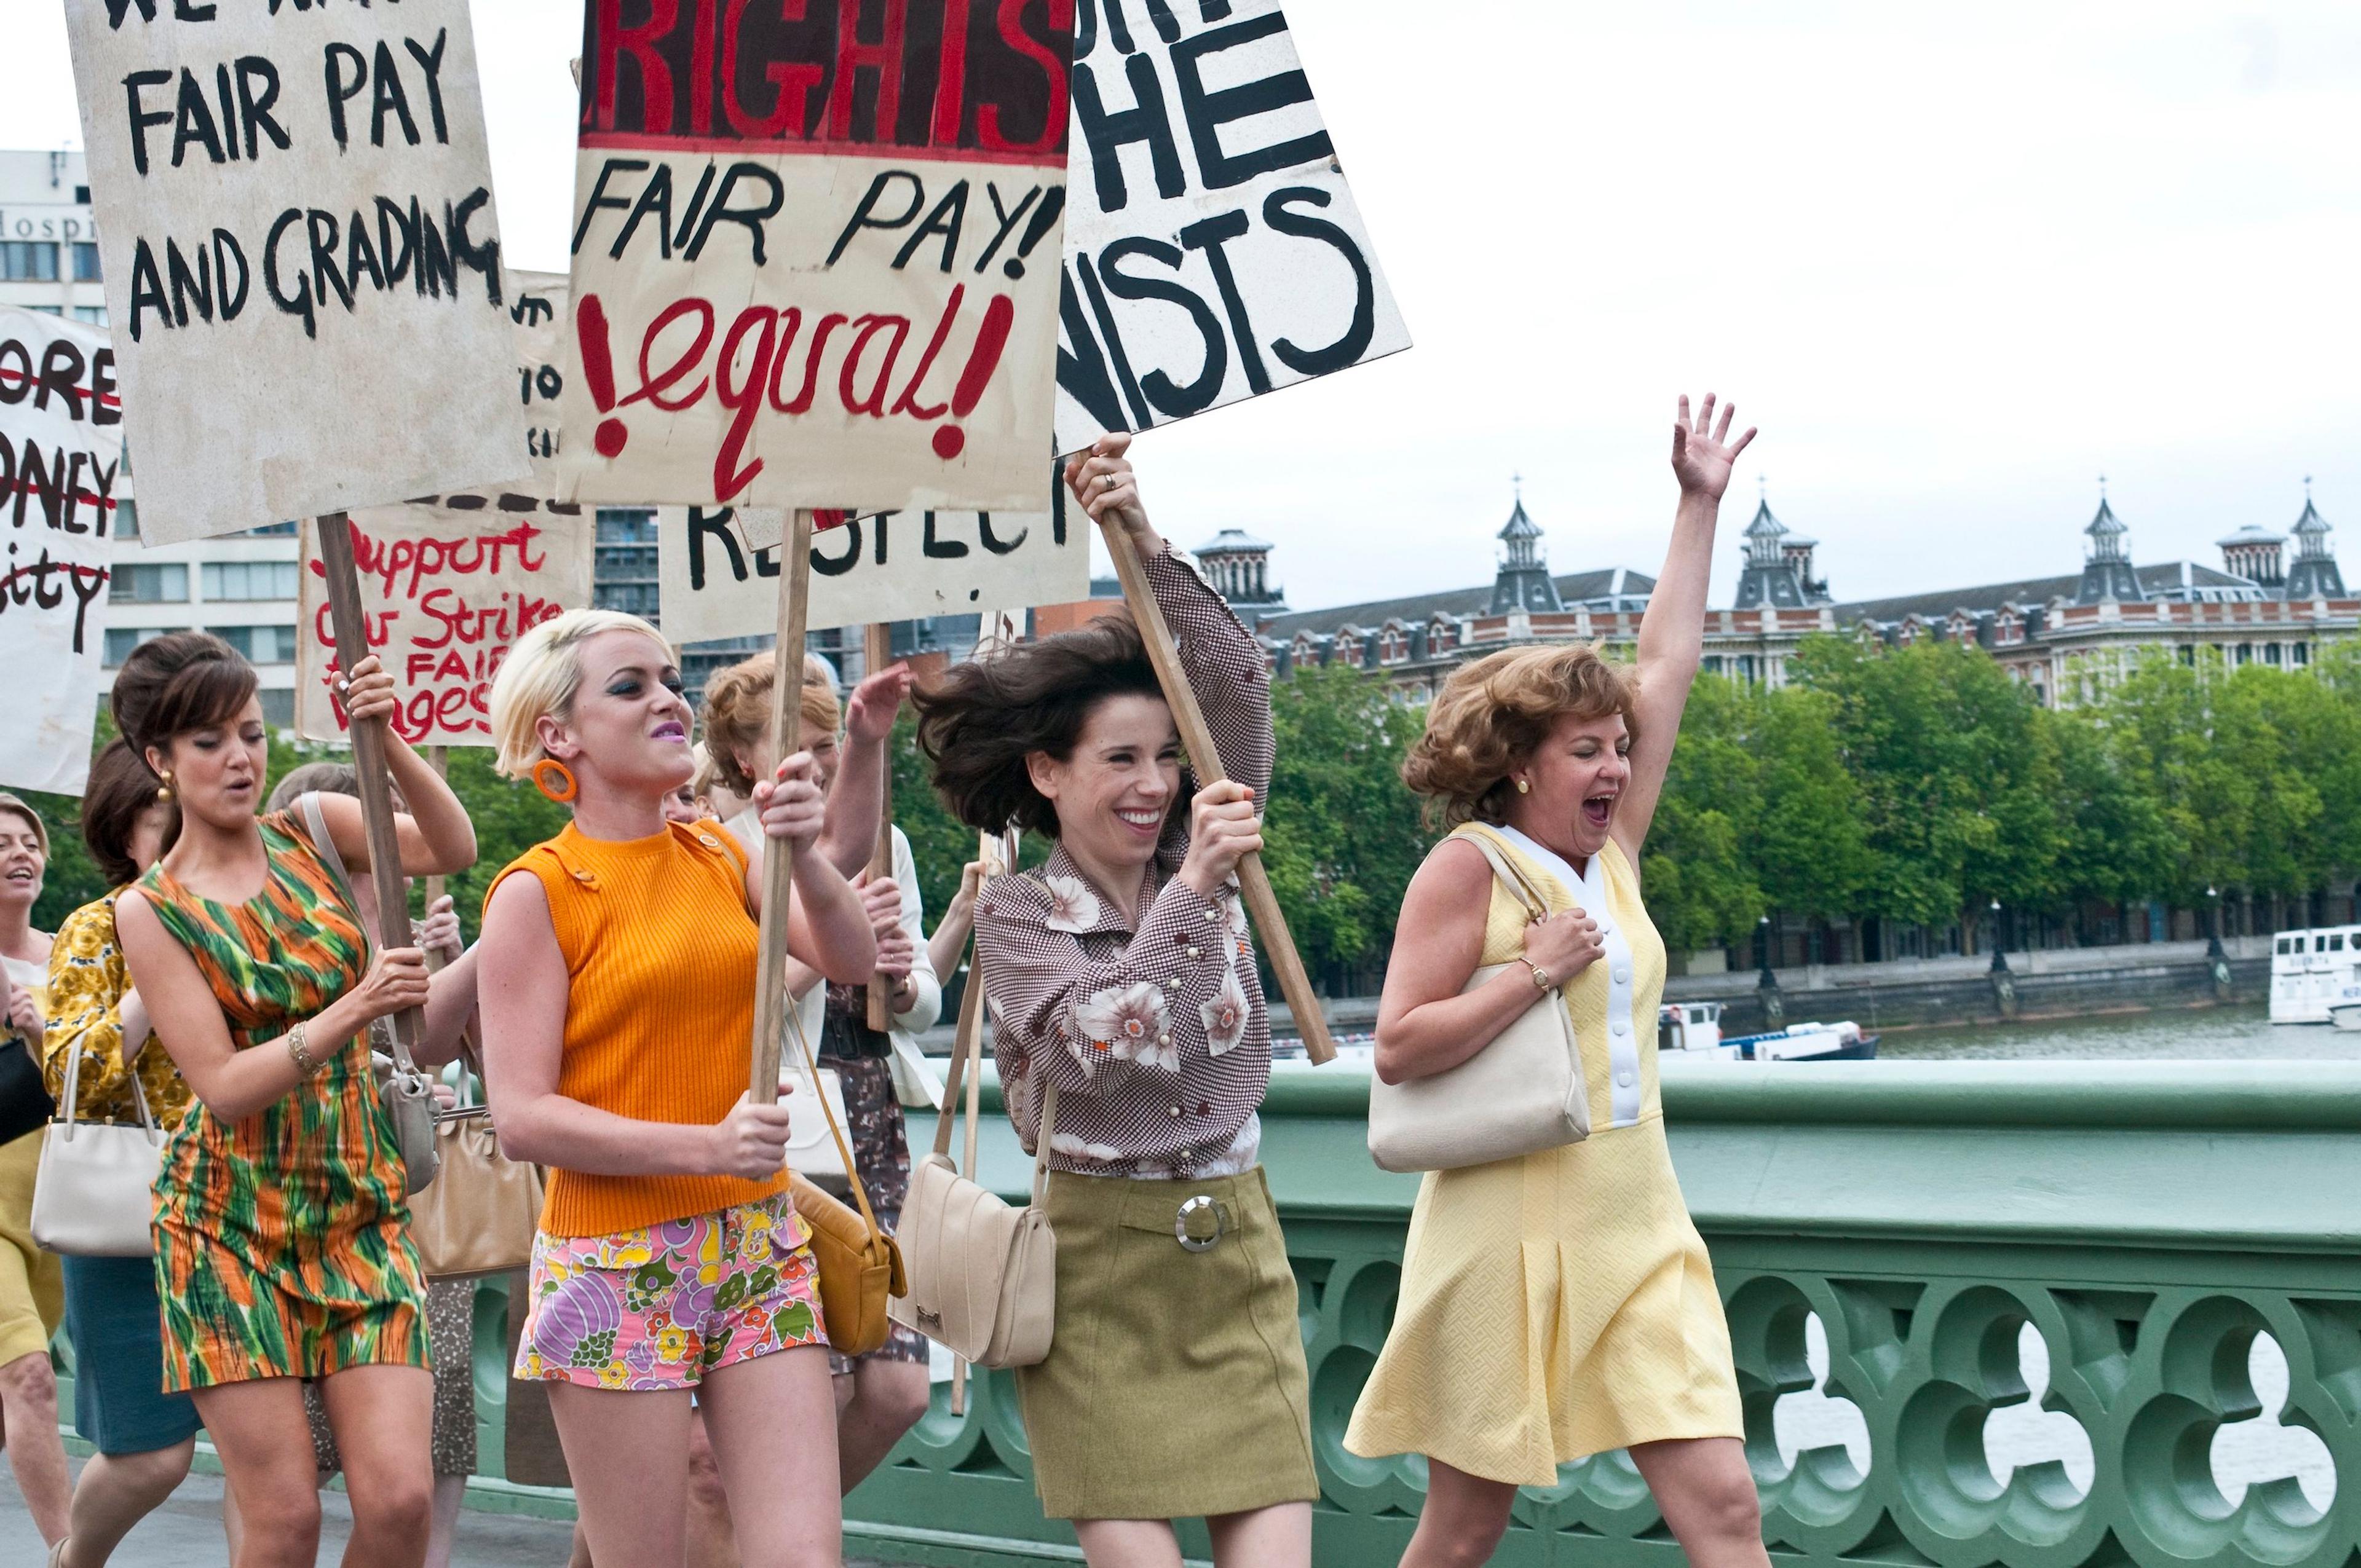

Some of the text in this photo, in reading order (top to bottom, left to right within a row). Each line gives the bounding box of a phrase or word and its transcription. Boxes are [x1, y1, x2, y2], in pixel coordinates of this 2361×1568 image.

[122, 27, 446, 176] FAIR PAY
[0, 210, 96, 247] ospi
[130, 187, 502, 342] AND GRADING
[572, 159, 1066, 280] FAIR PAY!
[0, 542, 108, 655] ity
